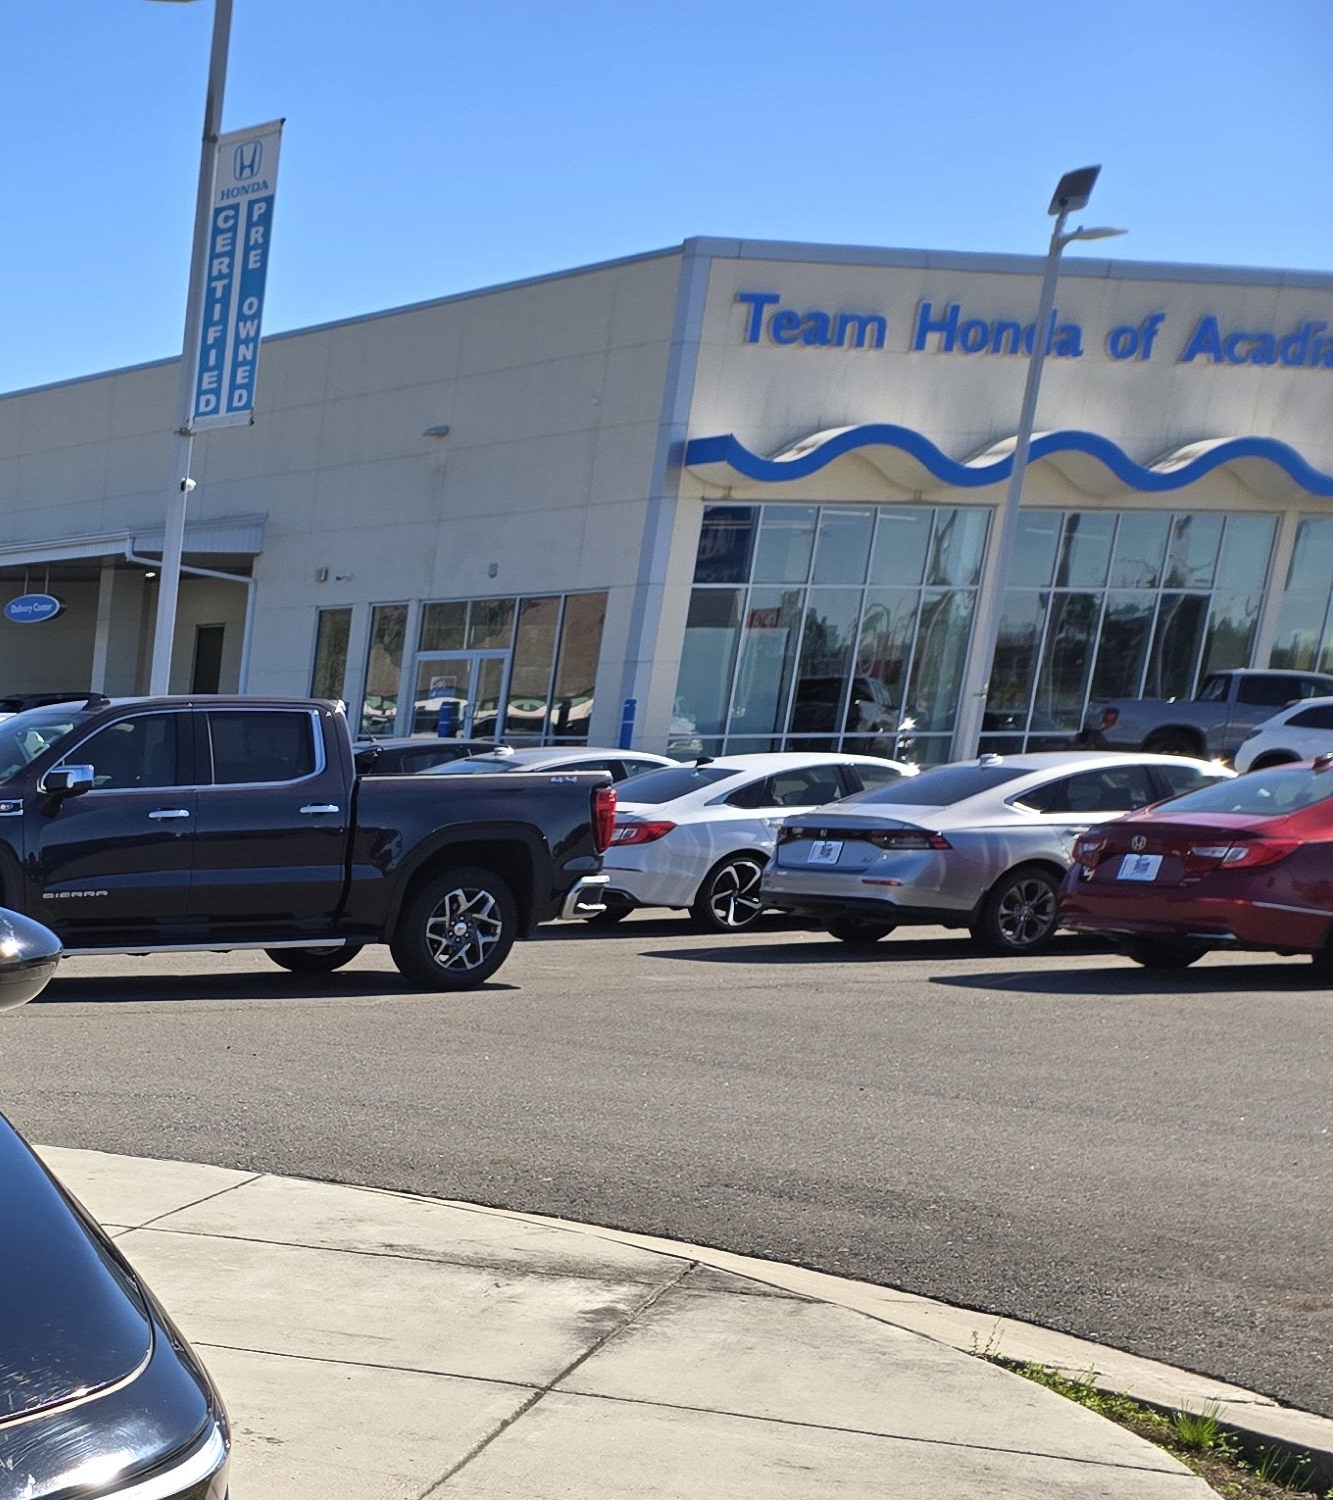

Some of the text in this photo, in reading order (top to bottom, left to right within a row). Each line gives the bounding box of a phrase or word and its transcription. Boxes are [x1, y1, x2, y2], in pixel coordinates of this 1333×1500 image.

[220, 180, 269, 200] HONDA
[198, 209, 235, 414] CERTIFIED
[232, 201, 267, 408] PRE OWNED
[738, 292, 887, 349] Team
[1109, 312, 1166, 361] of
[42, 890, 109, 899] SIERRA
